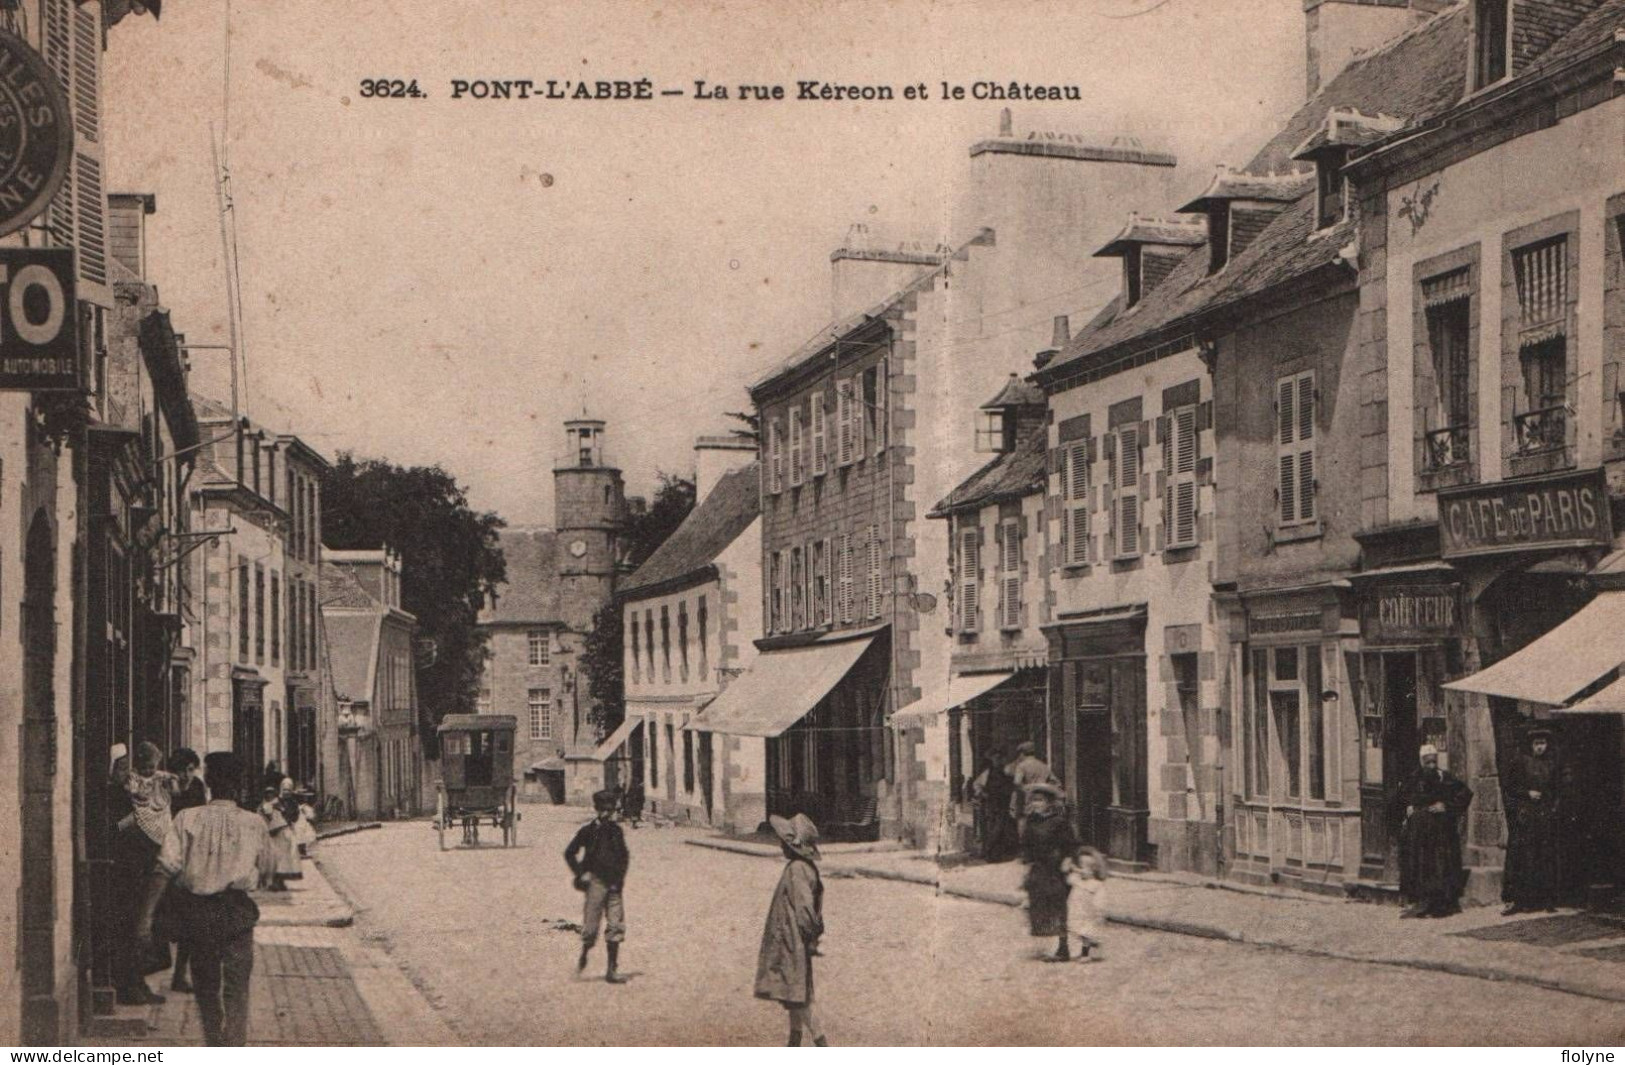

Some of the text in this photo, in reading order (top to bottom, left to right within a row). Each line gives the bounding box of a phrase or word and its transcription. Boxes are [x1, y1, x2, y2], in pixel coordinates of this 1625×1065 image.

[0, 264, 65, 345] O
[3, 358, 73, 375] AUTOMOBILE
[1527, 487, 1597, 535] PARIS
